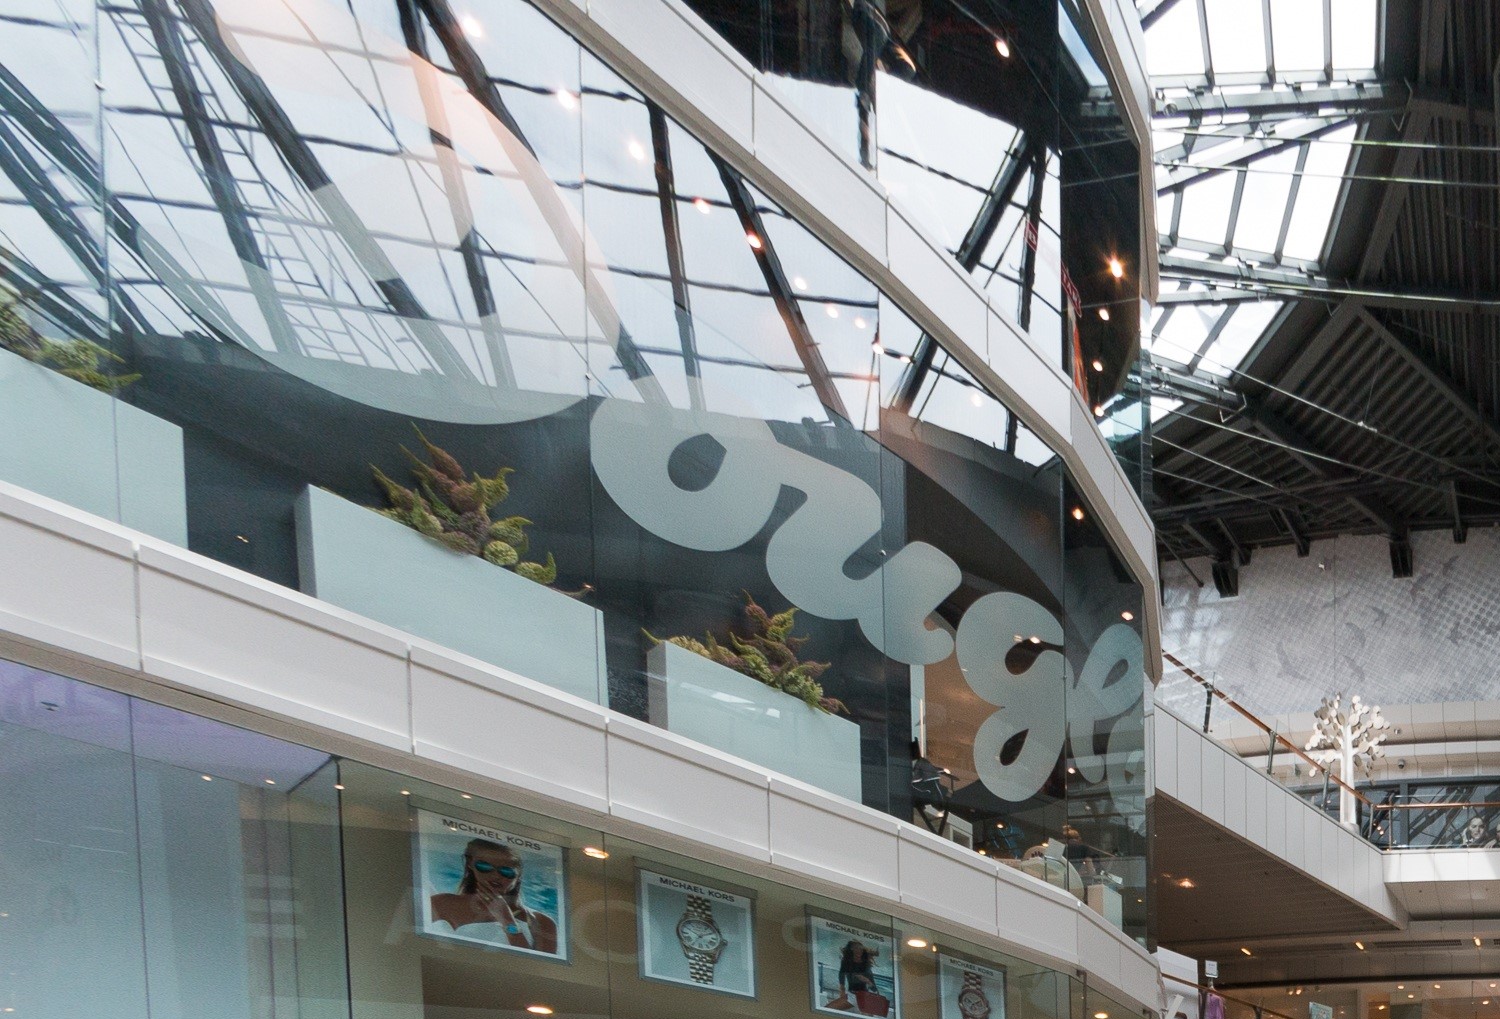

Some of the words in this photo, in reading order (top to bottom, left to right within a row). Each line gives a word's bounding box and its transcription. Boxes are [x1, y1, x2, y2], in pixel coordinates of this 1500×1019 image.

[442, 818, 503, 842] MICHAEL
[506, 835, 541, 851] KORS
[659, 876, 706, 895] MICHAEL
[707, 889, 736, 903] KORS
[825, 921, 862, 937] MICHAEL
[863, 931, 886, 943] KORS
[949, 958, 977, 973] MICHAEL
[977, 966, 994, 977] KORS
